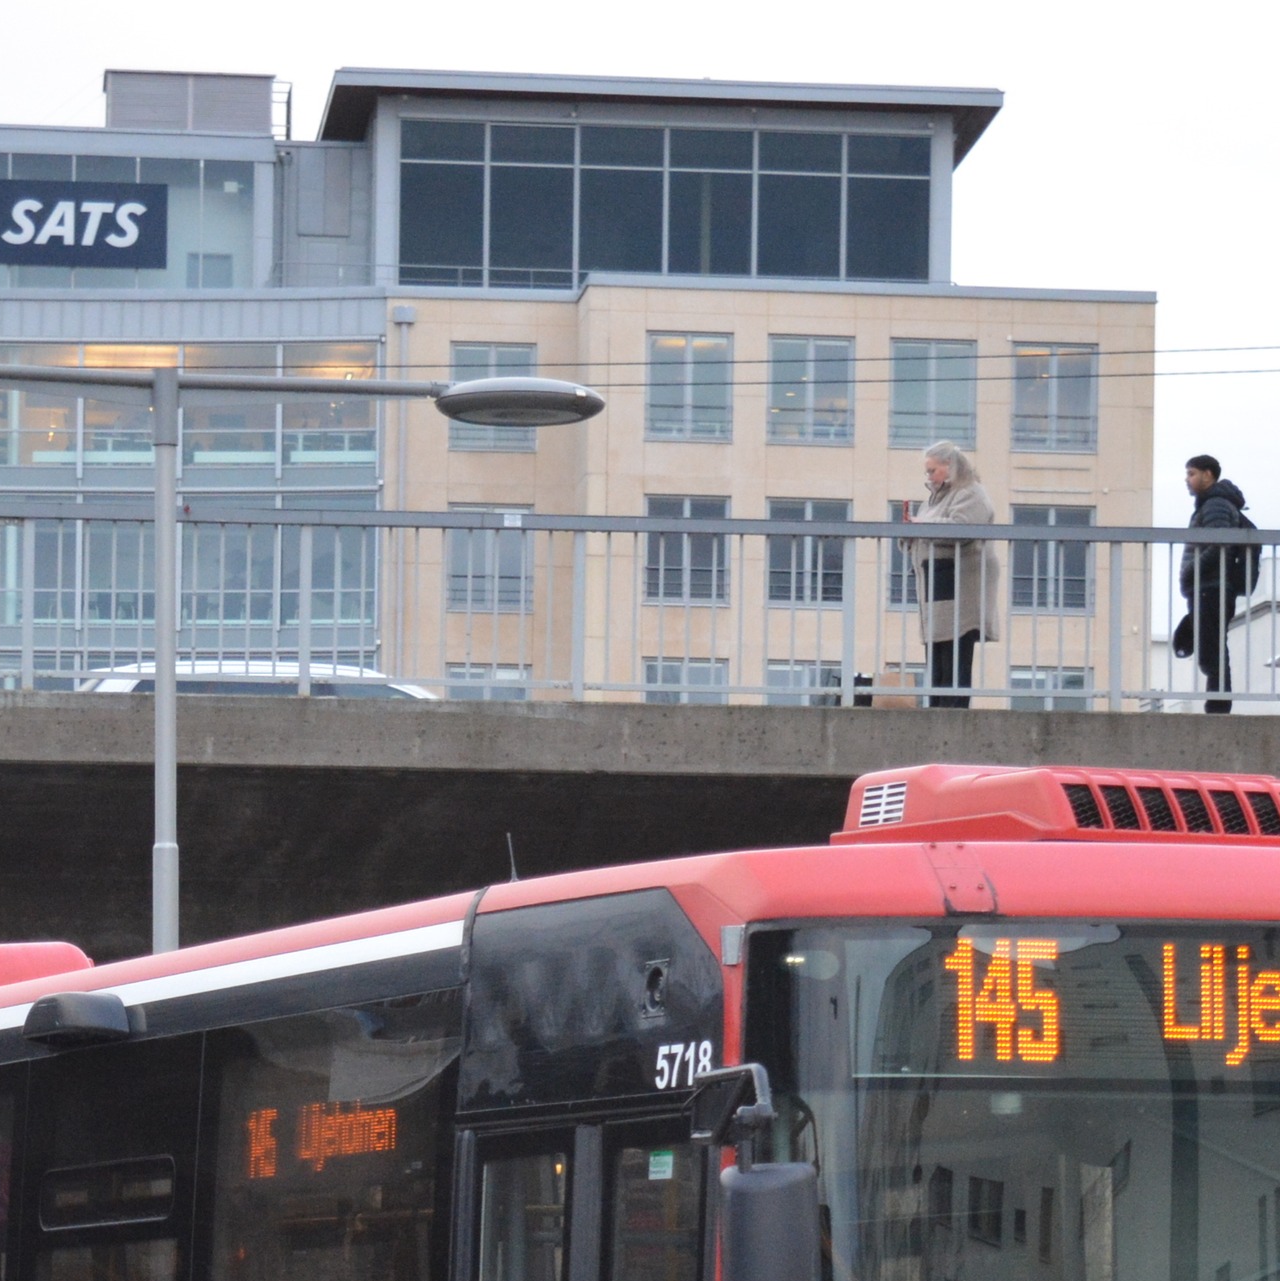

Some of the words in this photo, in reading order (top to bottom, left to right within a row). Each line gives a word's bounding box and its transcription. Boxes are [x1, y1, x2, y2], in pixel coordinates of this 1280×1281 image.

[1, 199, 148, 248] SATS
[945, 938, 1059, 1061] 145
[655, 1040, 712, 1090] 5718
